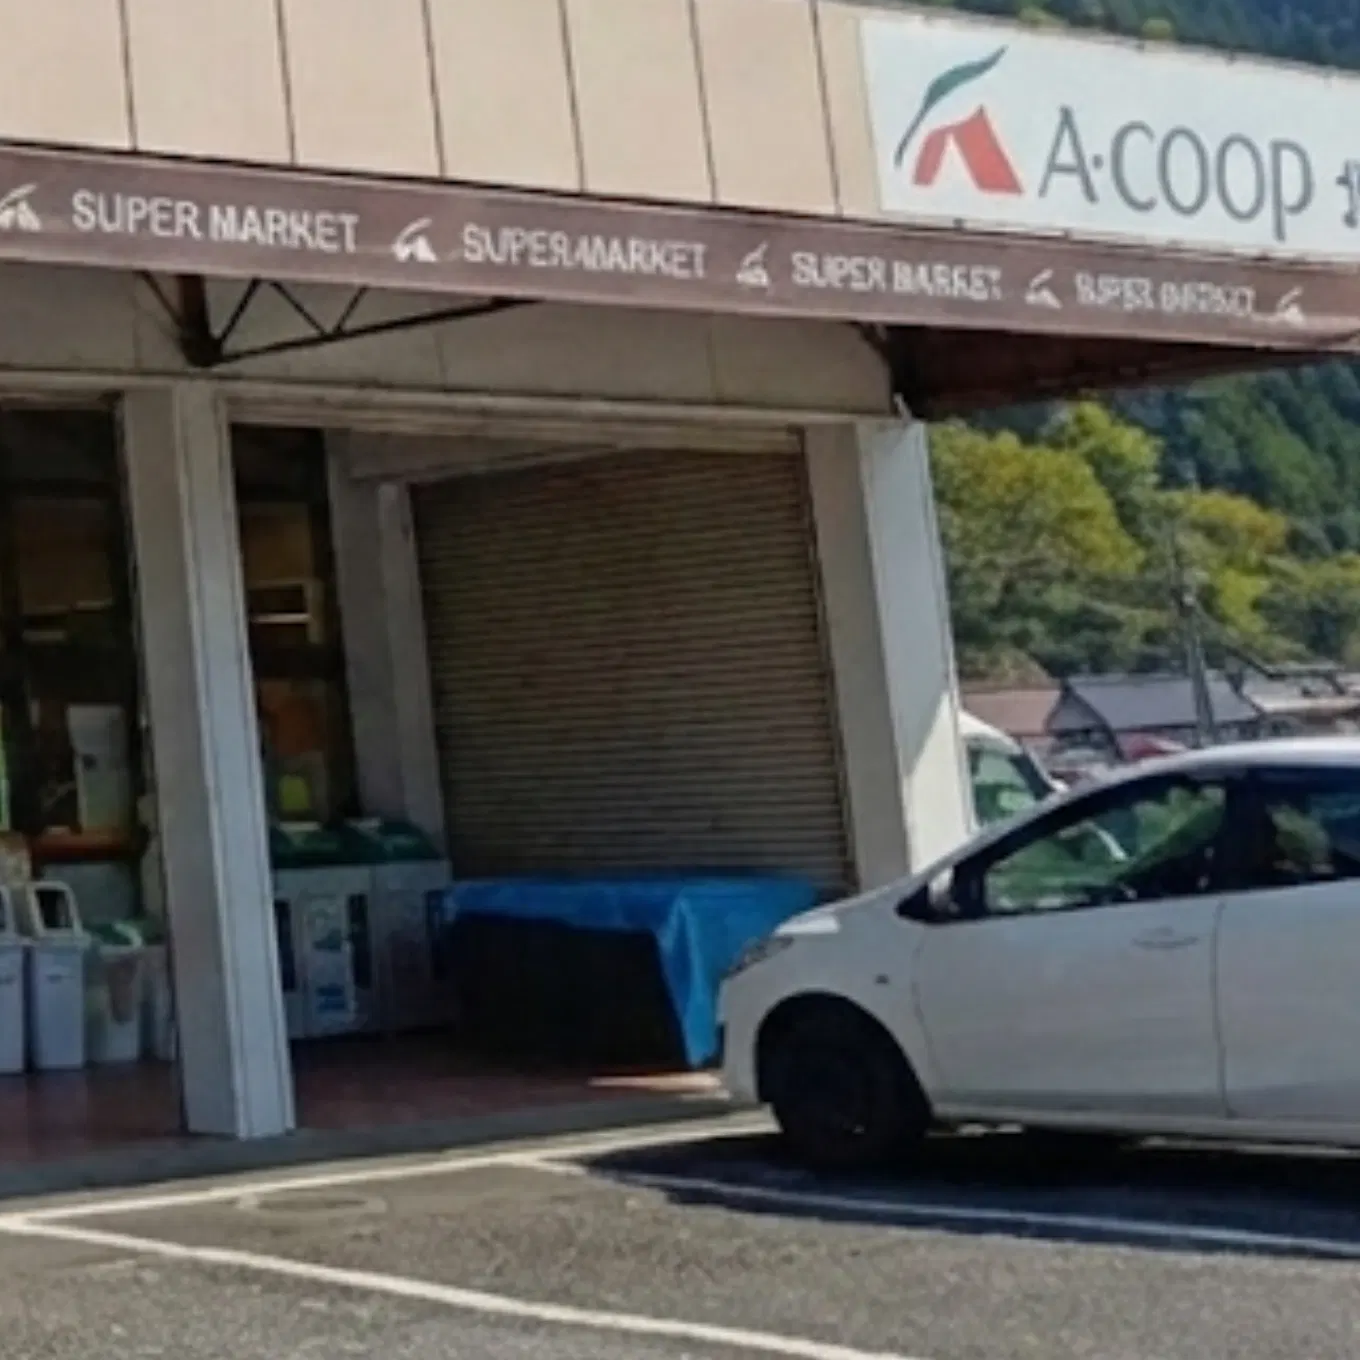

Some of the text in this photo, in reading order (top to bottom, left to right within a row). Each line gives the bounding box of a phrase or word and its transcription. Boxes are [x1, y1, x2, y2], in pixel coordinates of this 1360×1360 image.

[71, 190, 359, 253] SUPER MARKET
[463, 223, 572, 266] SUPER
